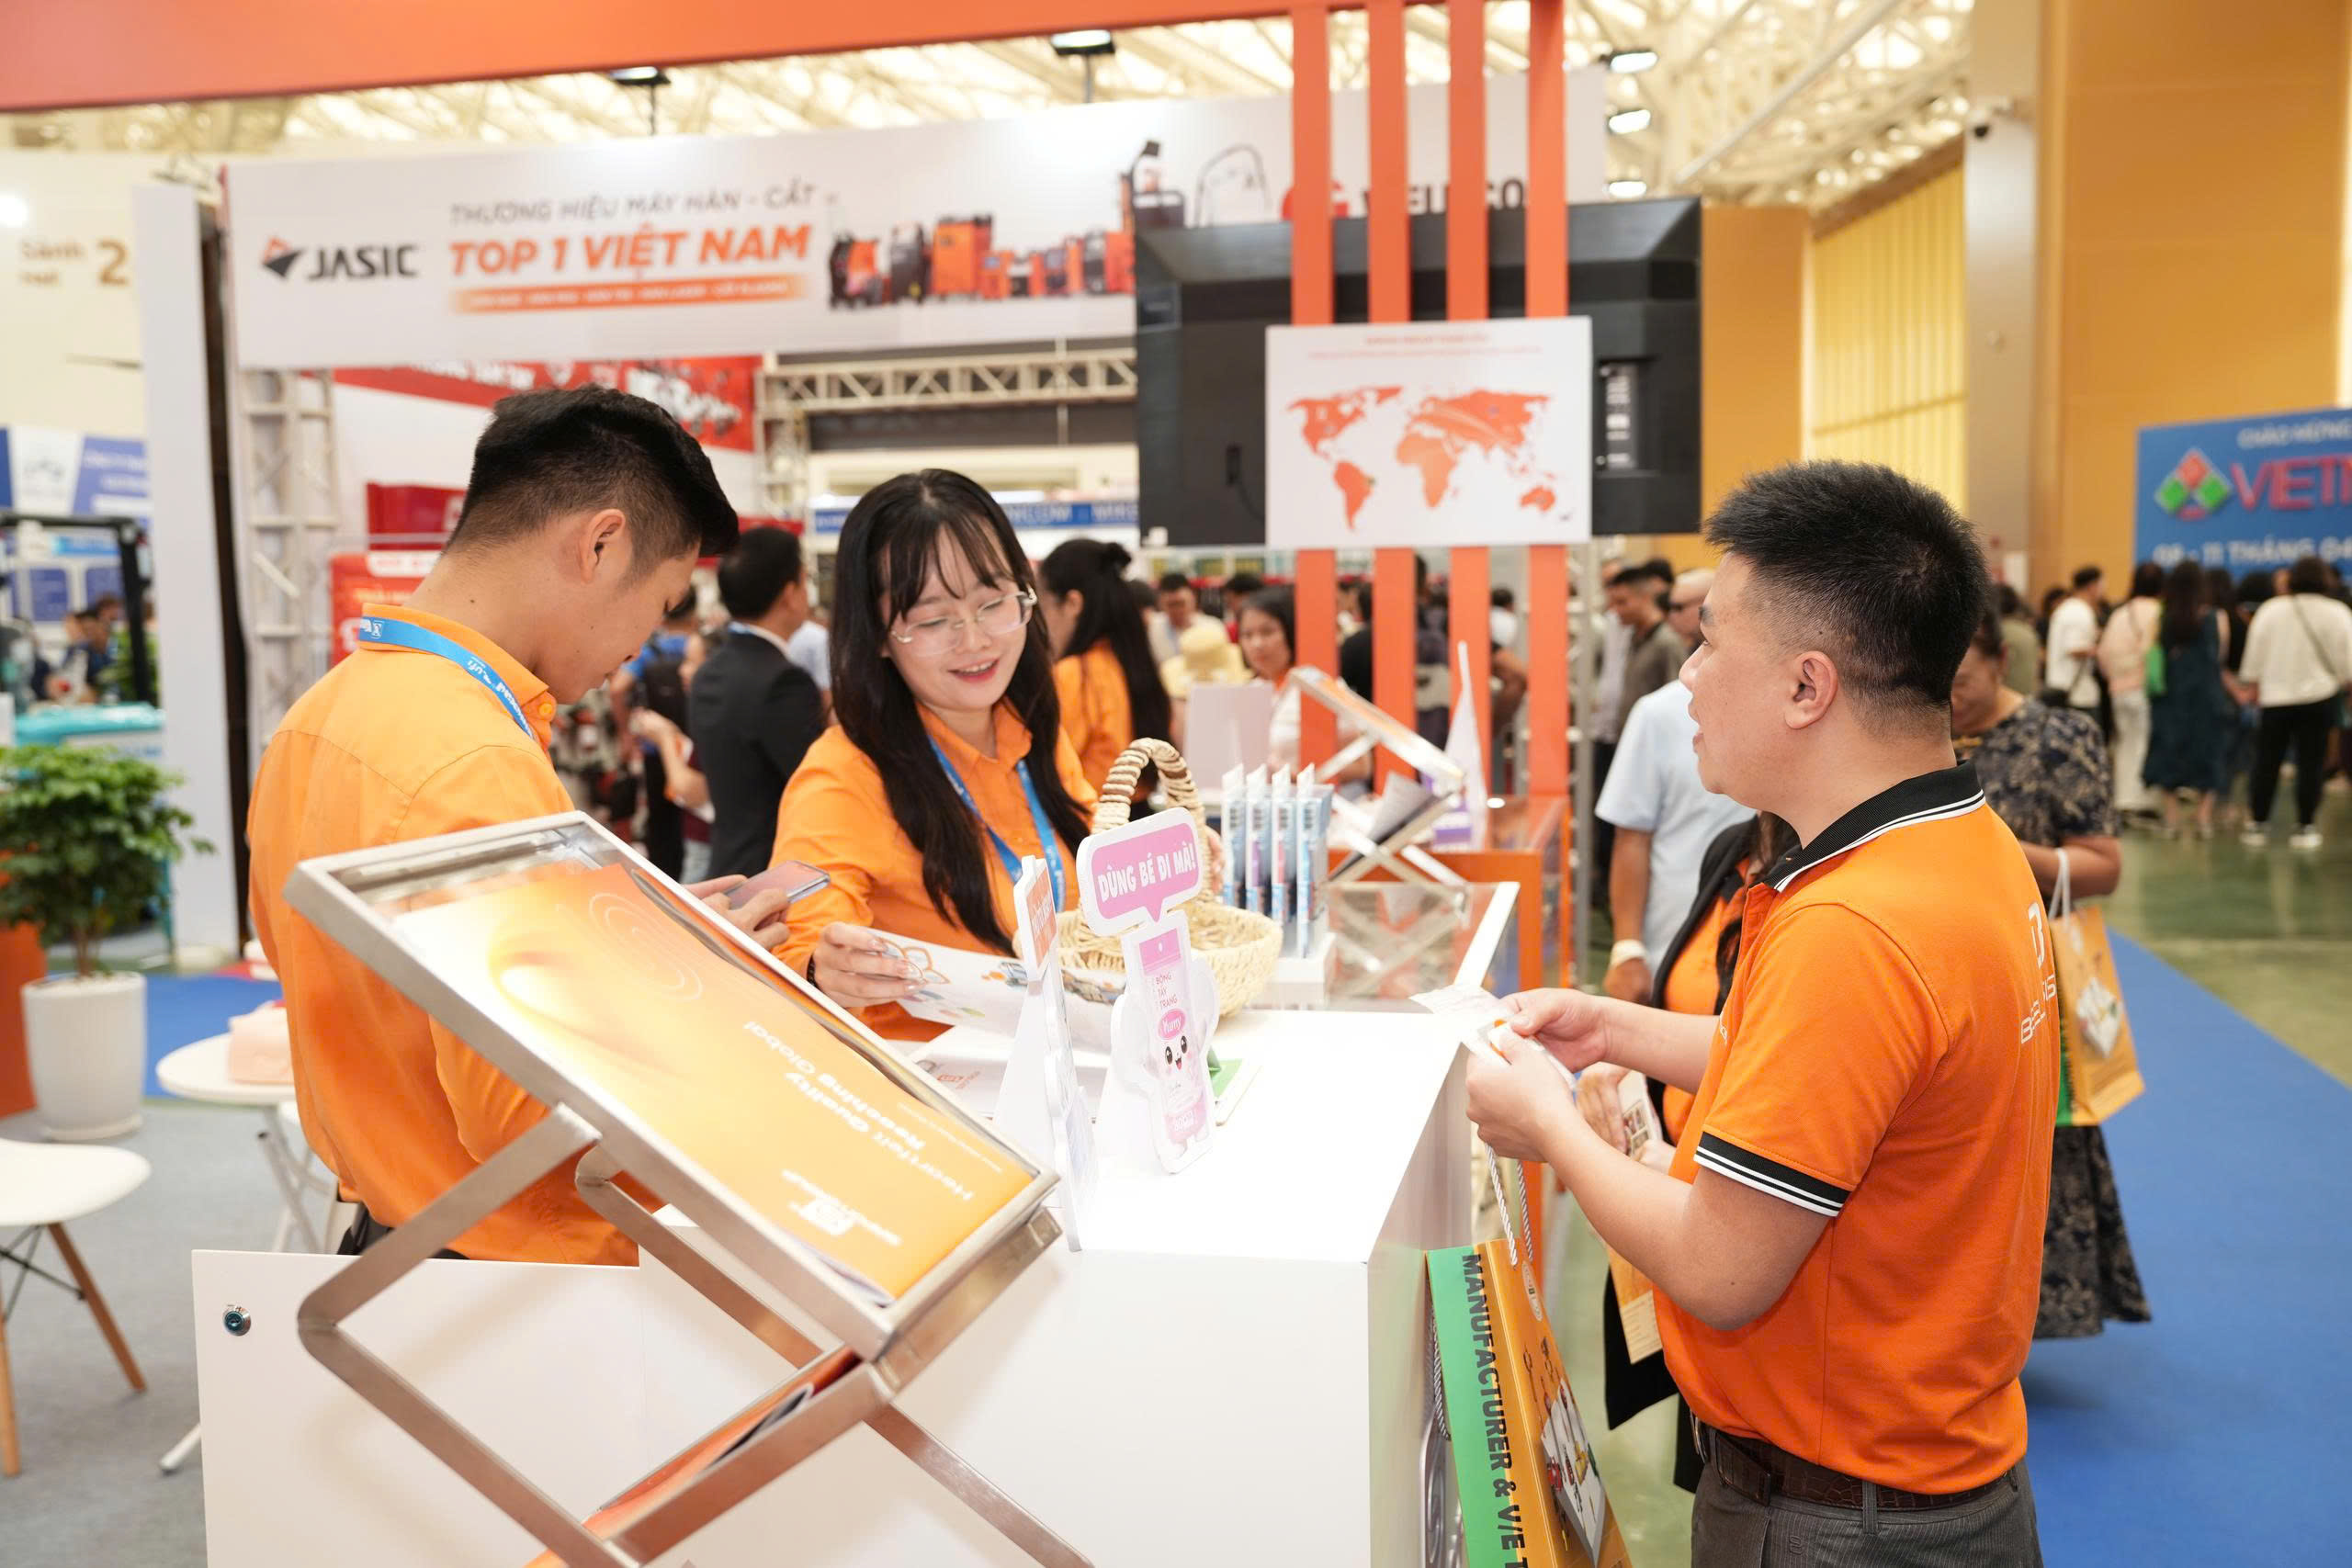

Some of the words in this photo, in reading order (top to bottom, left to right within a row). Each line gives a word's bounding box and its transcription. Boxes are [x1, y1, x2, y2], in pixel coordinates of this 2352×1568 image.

[97, 239, 130, 286] 2
[306, 243, 419, 281] JASIC
[448, 237, 538, 277] TOP
[553, 235, 570, 271] 1
[583, 220, 690, 276] VIỆT
[698, 223, 813, 266] NAM
[1097, 864, 1137, 903] DÙNG
[1138, 852, 1156, 887] BÉ
[741, 1021, 818, 1075] Global
[785, 1071, 871, 1134] Quality
[1462, 1253, 1513, 1472] MANUFACTURER
[1492, 1478, 1517, 1498] &
